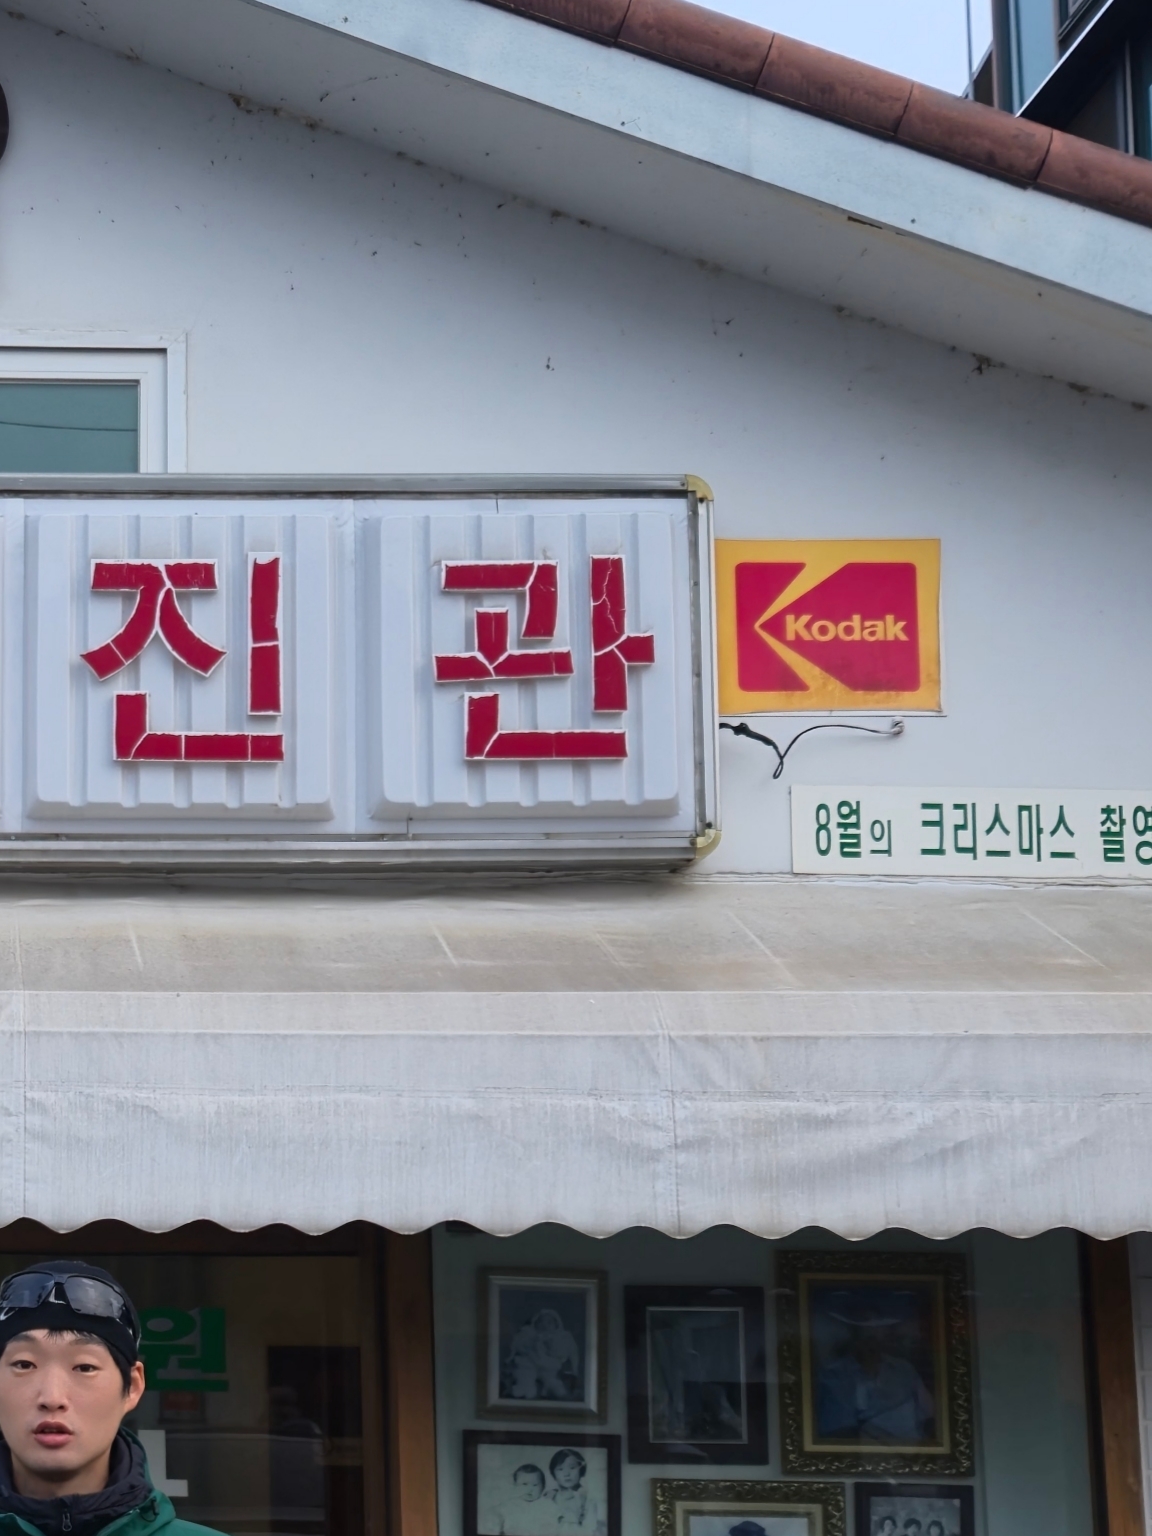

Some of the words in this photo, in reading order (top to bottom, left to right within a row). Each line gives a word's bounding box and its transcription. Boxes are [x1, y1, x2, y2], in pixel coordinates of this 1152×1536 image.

[785, 614, 909, 642] Kodak
[815, 800, 893, 859] 8월의
[920, 803, 1076, 862] 크리스마스
